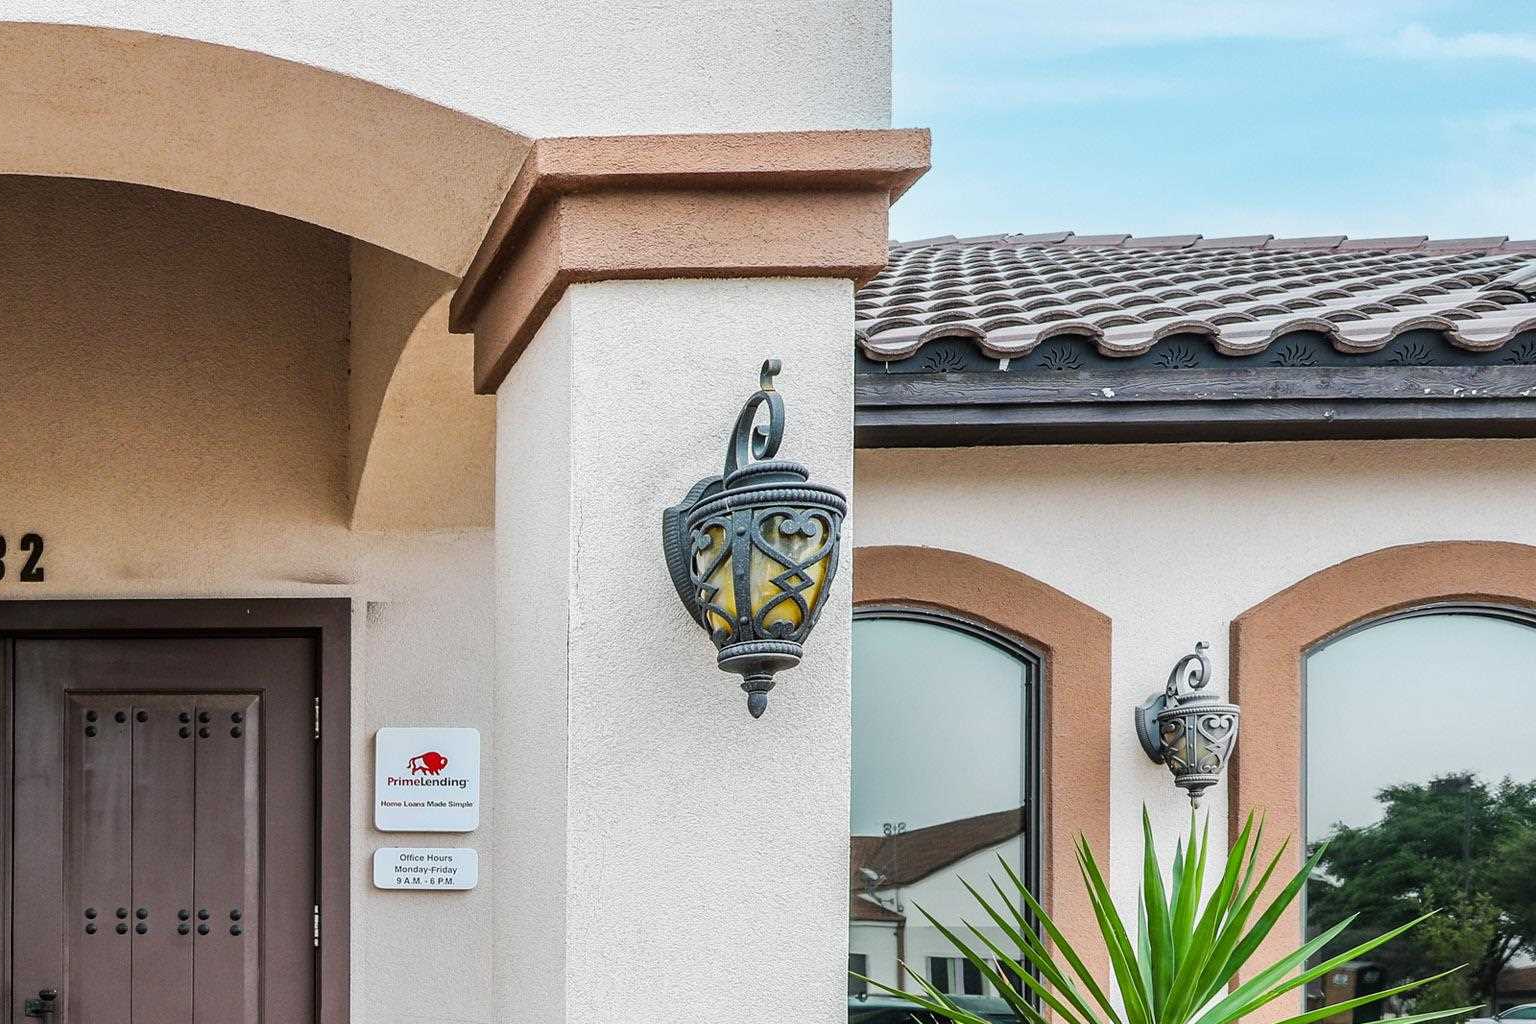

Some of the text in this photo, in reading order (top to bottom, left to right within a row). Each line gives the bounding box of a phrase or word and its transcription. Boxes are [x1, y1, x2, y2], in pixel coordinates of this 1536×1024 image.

[387, 777, 466, 789] PrimeLending
[448, 801, 473, 809] Simple
[399, 854, 453, 862] Office Hours
[395, 866, 457, 874] Monday-Friday
[396, 877, 402, 885] 9
